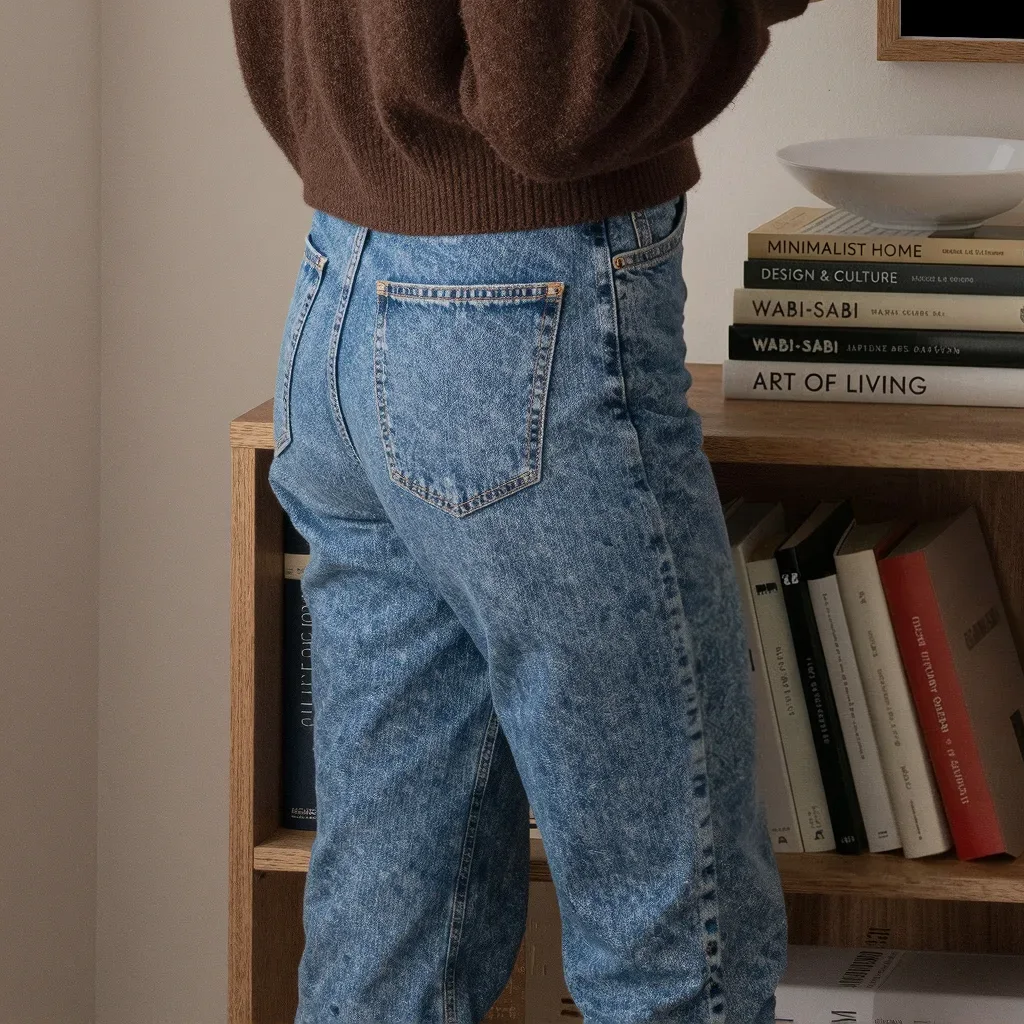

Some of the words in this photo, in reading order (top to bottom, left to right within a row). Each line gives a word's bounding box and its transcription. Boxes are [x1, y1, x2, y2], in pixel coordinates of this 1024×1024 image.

[767, 240, 867, 256] MINIMALIST
[872, 243, 922, 258] HOME
[761, 267, 815, 282] DESIGN
[820, 269, 830, 282] &
[834, 270, 898, 284] CULTURE
[752, 300, 858, 319] WABI-SABI
[753, 372, 796, 391] ART
[804, 373, 837, 392] OF
[847, 374, 927, 395] LIVING
